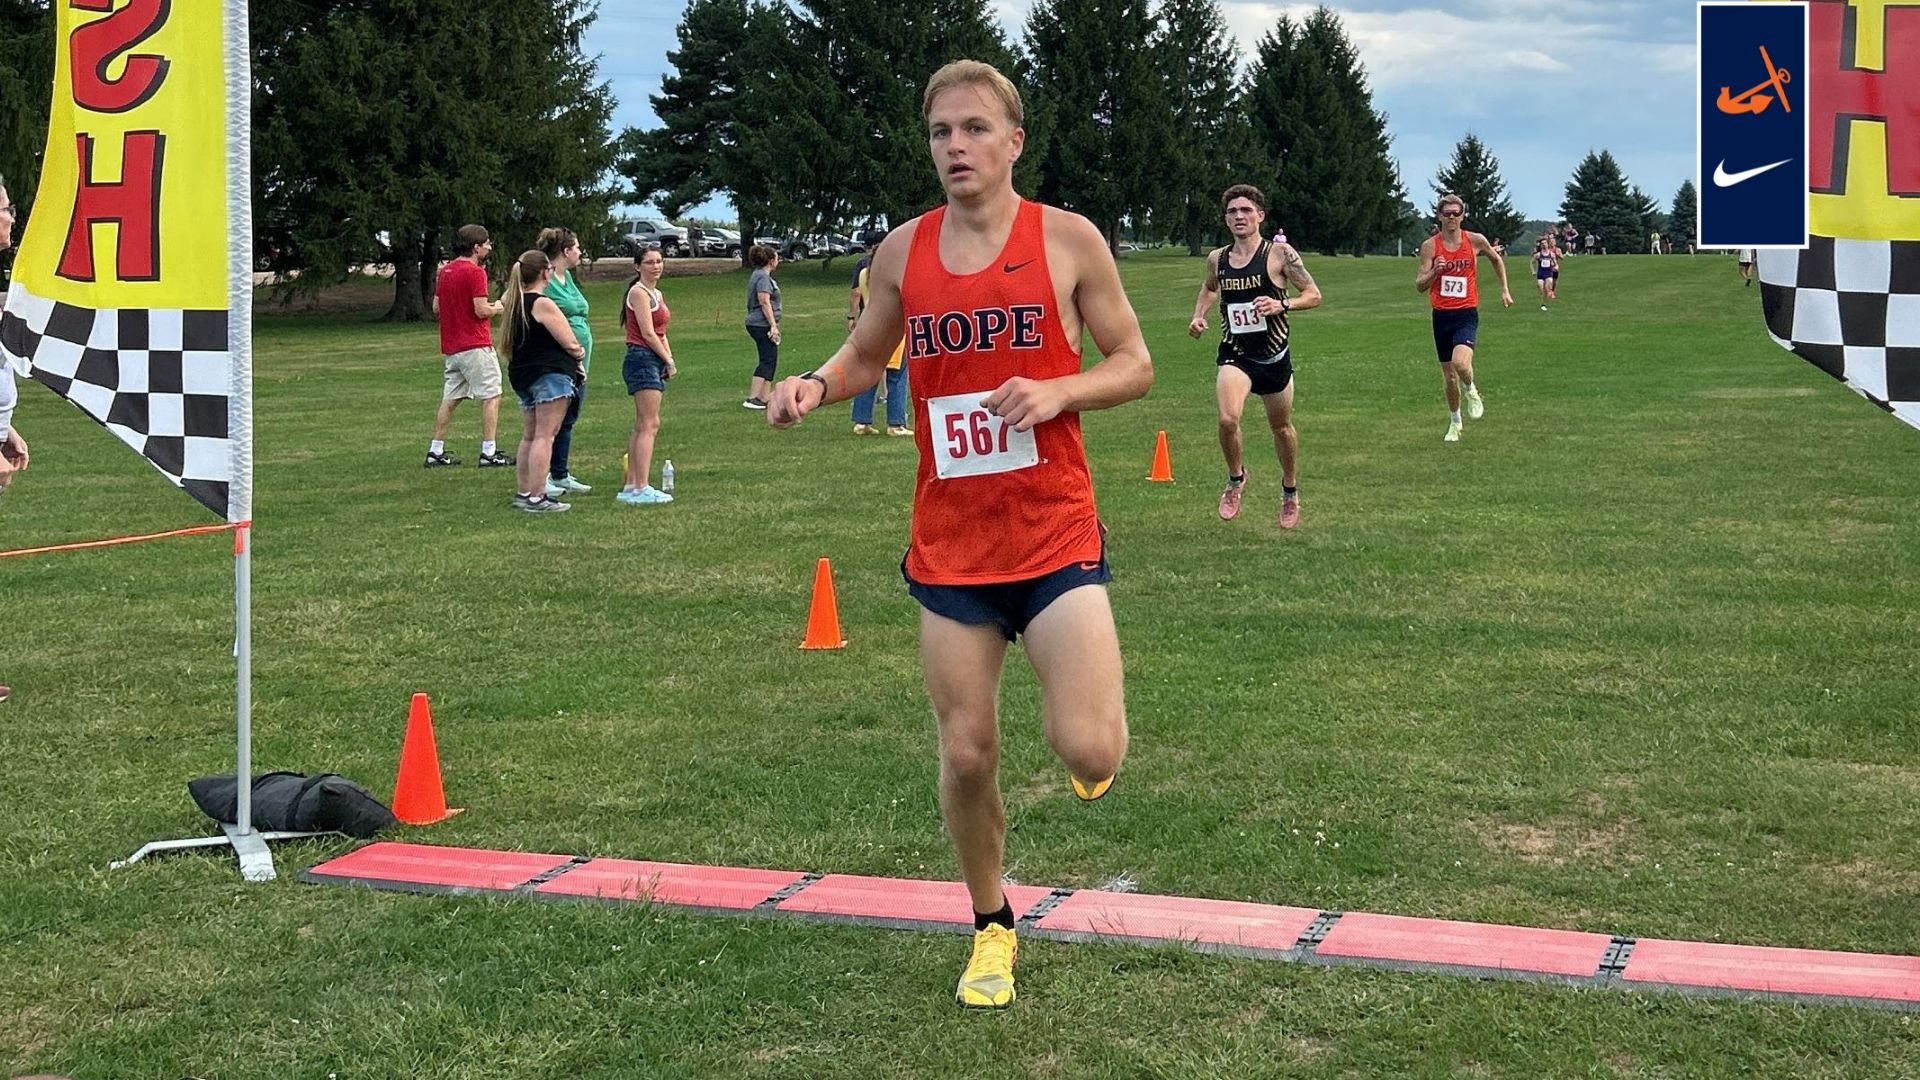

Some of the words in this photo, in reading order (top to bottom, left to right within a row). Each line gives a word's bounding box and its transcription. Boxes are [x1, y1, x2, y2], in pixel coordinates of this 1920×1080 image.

[1444, 280, 1464, 293] 573
[1232, 309, 1261, 327] 513
[908, 304, 1044, 359] HOPE
